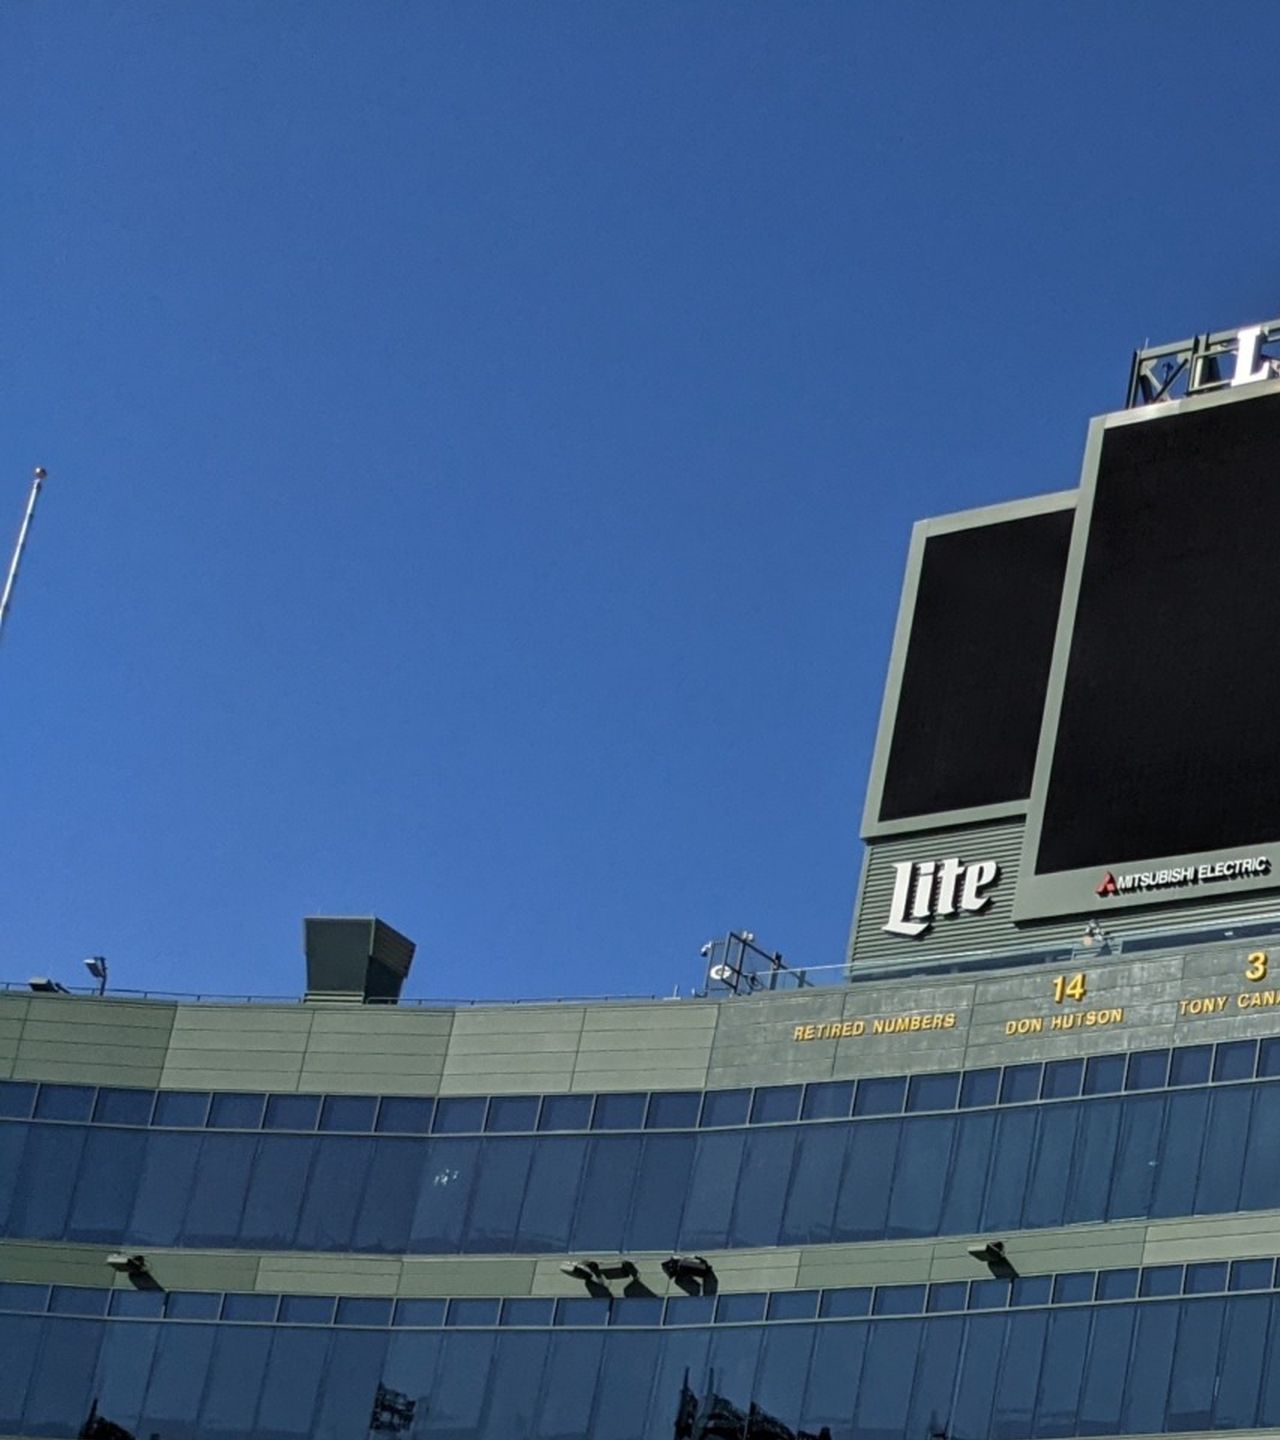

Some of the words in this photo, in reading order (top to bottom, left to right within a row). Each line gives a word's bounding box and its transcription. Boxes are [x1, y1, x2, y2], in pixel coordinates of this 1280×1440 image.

[1117, 867, 1195, 890] MITSUBISHI
[1198, 855, 1267, 881] ELECTRIC
[882, 857, 998, 936] Lite
[1244, 952, 1269, 981] 3
[1051, 973, 1086, 1002] 14
[1179, 995, 1228, 1015] TONY
[793, 1019, 864, 1040] RETIRED
[872, 1012, 956, 1034] NUMBERS
[1005, 1016, 1043, 1035] DON
[1050, 1008, 1123, 1029] HUTSON
